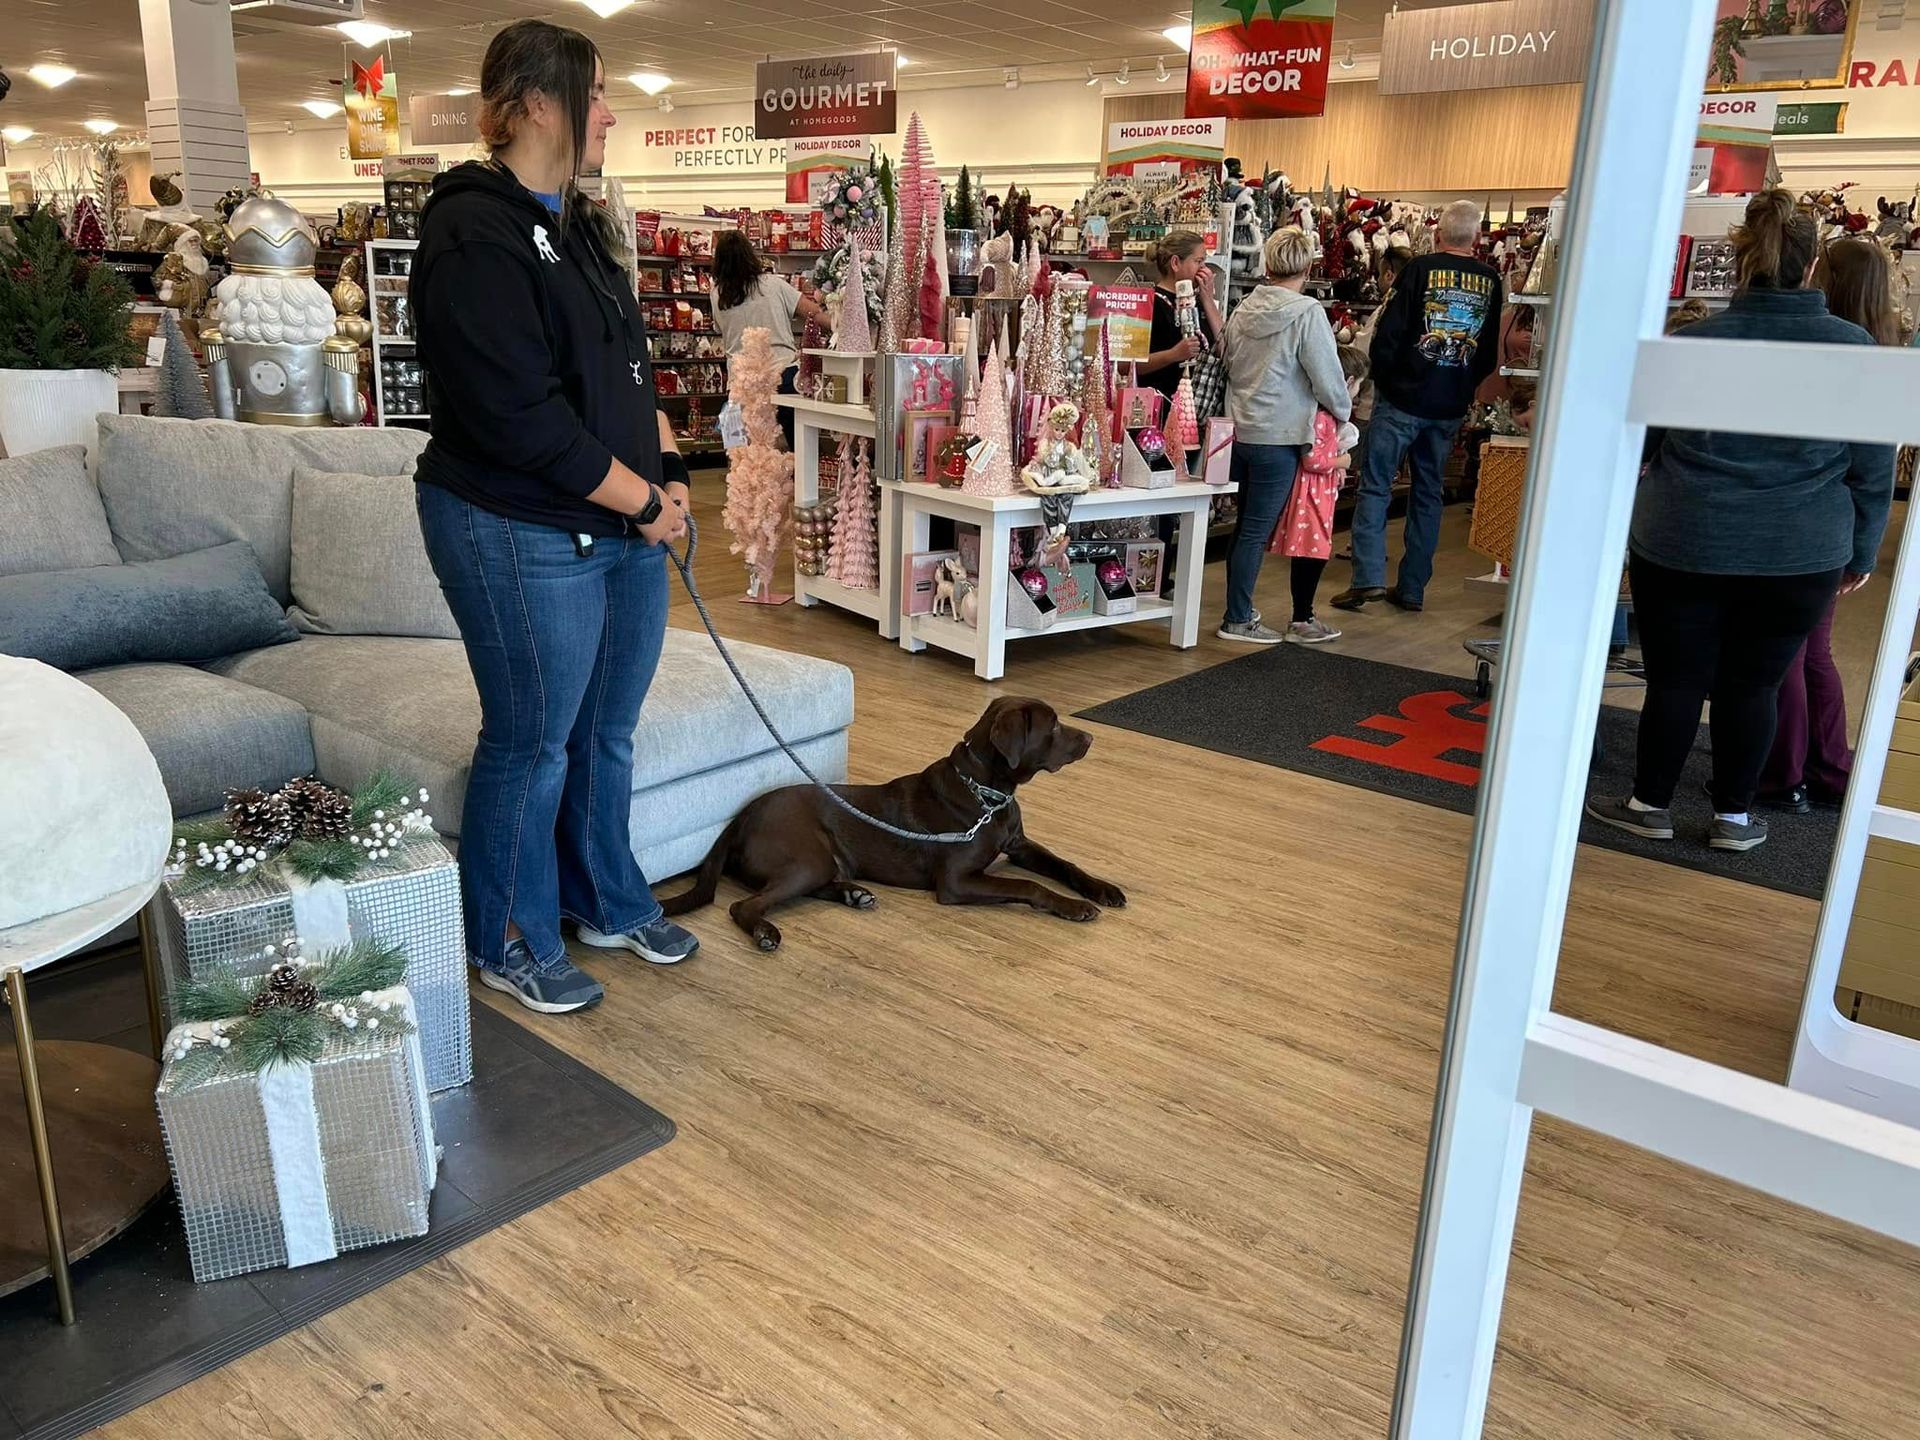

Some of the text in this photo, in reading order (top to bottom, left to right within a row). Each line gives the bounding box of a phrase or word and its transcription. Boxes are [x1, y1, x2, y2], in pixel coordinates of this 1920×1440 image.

[1429, 30, 1557, 61] HOLIDAY
[1196, 47, 1322, 69] OH-WHAT-FUN
[792, 62, 855, 81] the daily
[1209, 69, 1302, 96] DECOR
[762, 80, 888, 112] GOURMET
[431, 112, 467, 127] DINING
[789, 115, 858, 126] AT HOMEGOODS
[645, 126, 755, 147] PERFECT FOR
[1120, 124, 1212, 138] HOLIDAY DECOR
[794, 140, 830, 151] HOLIDAY
[831, 139, 861, 149] DECOR
[416, 157, 435, 165] FOOD
[674, 148, 762, 167] PERFECTLY
[1096, 291, 1148, 302] INCREDIBLE
[1105, 301, 1137, 310] PRICES
